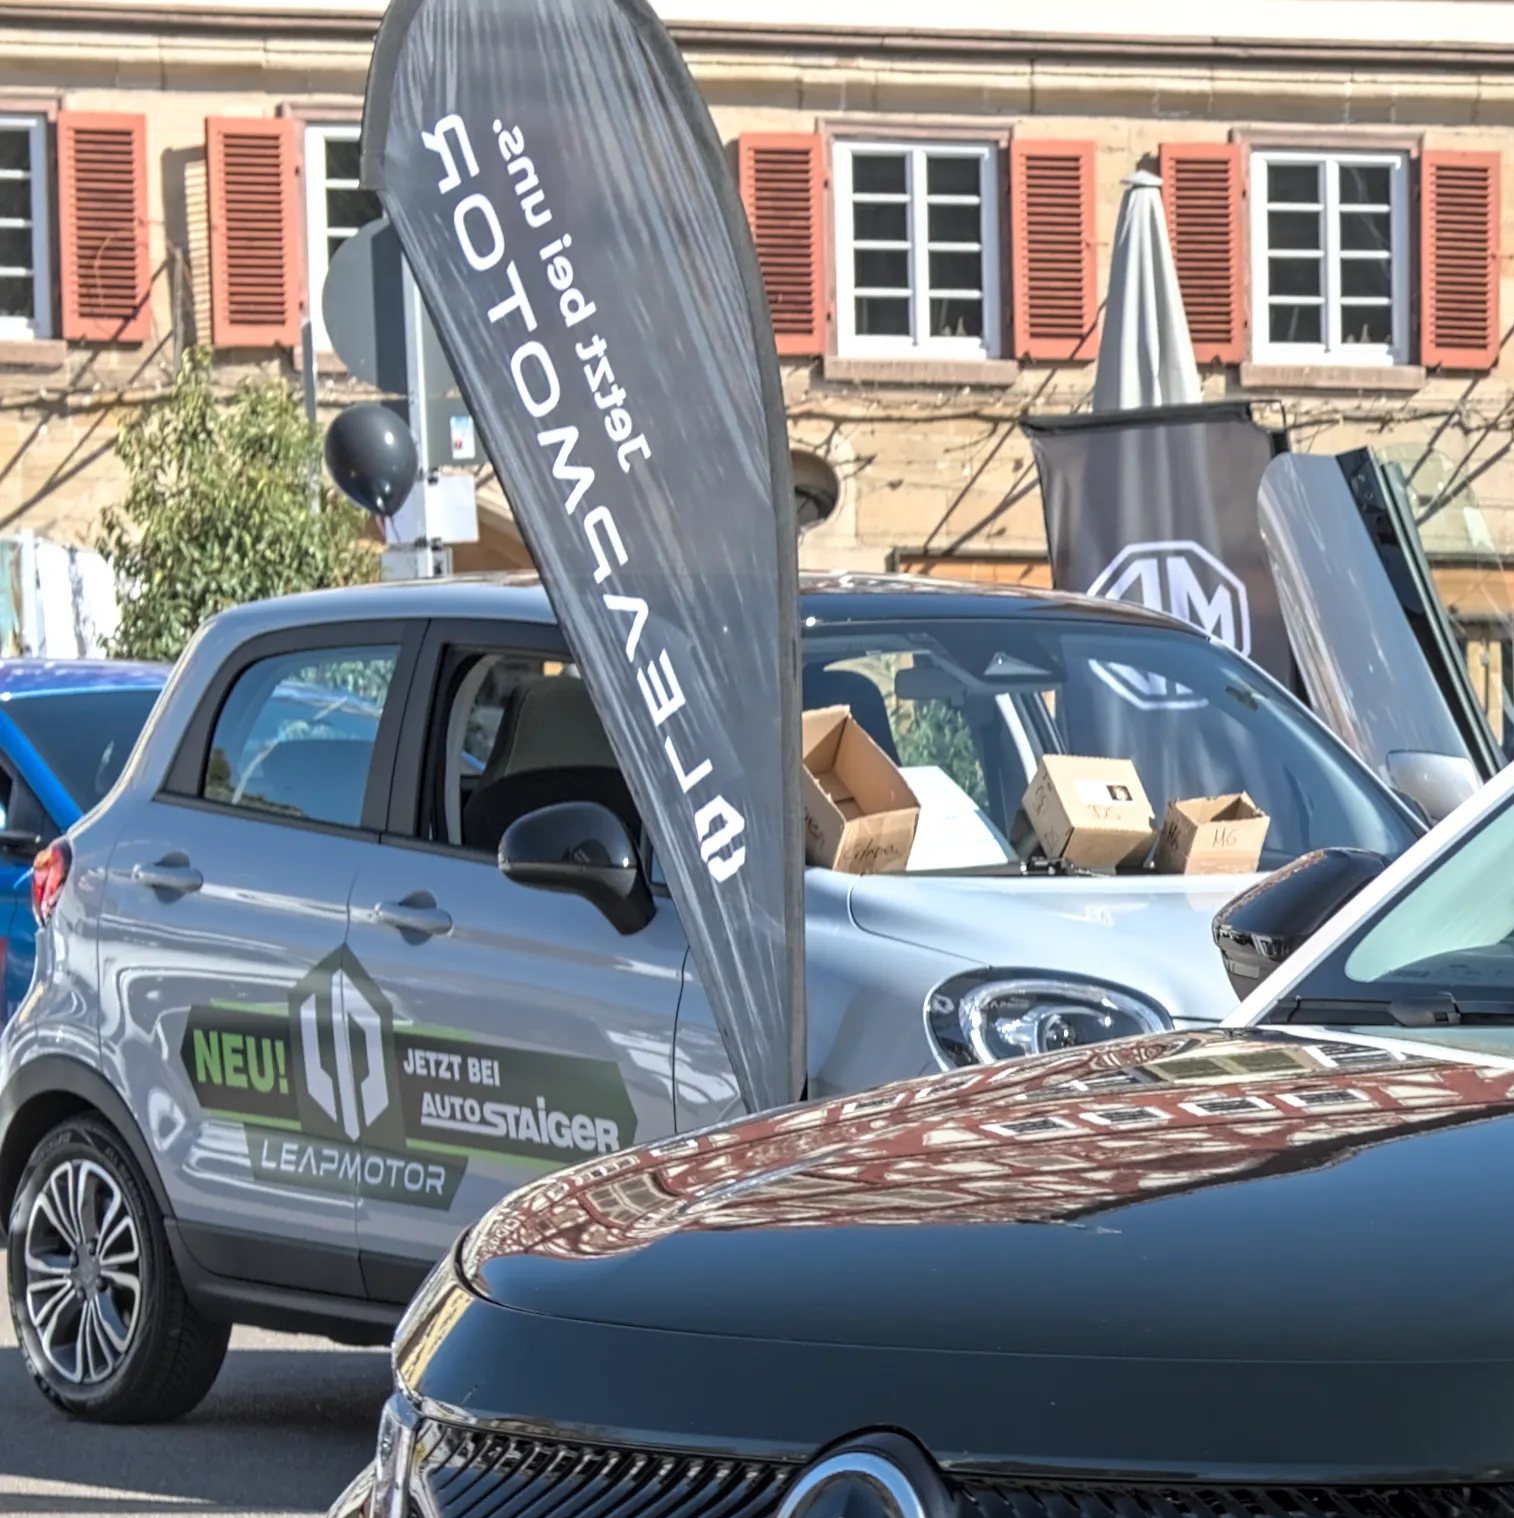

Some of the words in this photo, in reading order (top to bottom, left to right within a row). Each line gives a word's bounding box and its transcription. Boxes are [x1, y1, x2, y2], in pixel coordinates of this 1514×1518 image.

[193, 1029, 289, 1095] NEU!
[403, 1048, 462, 1082] JETZT
[467, 1057, 501, 1087] BEI
[420, 1092, 482, 1123] AUTO
[260, 1139, 446, 1195] LEAPMOTOR
